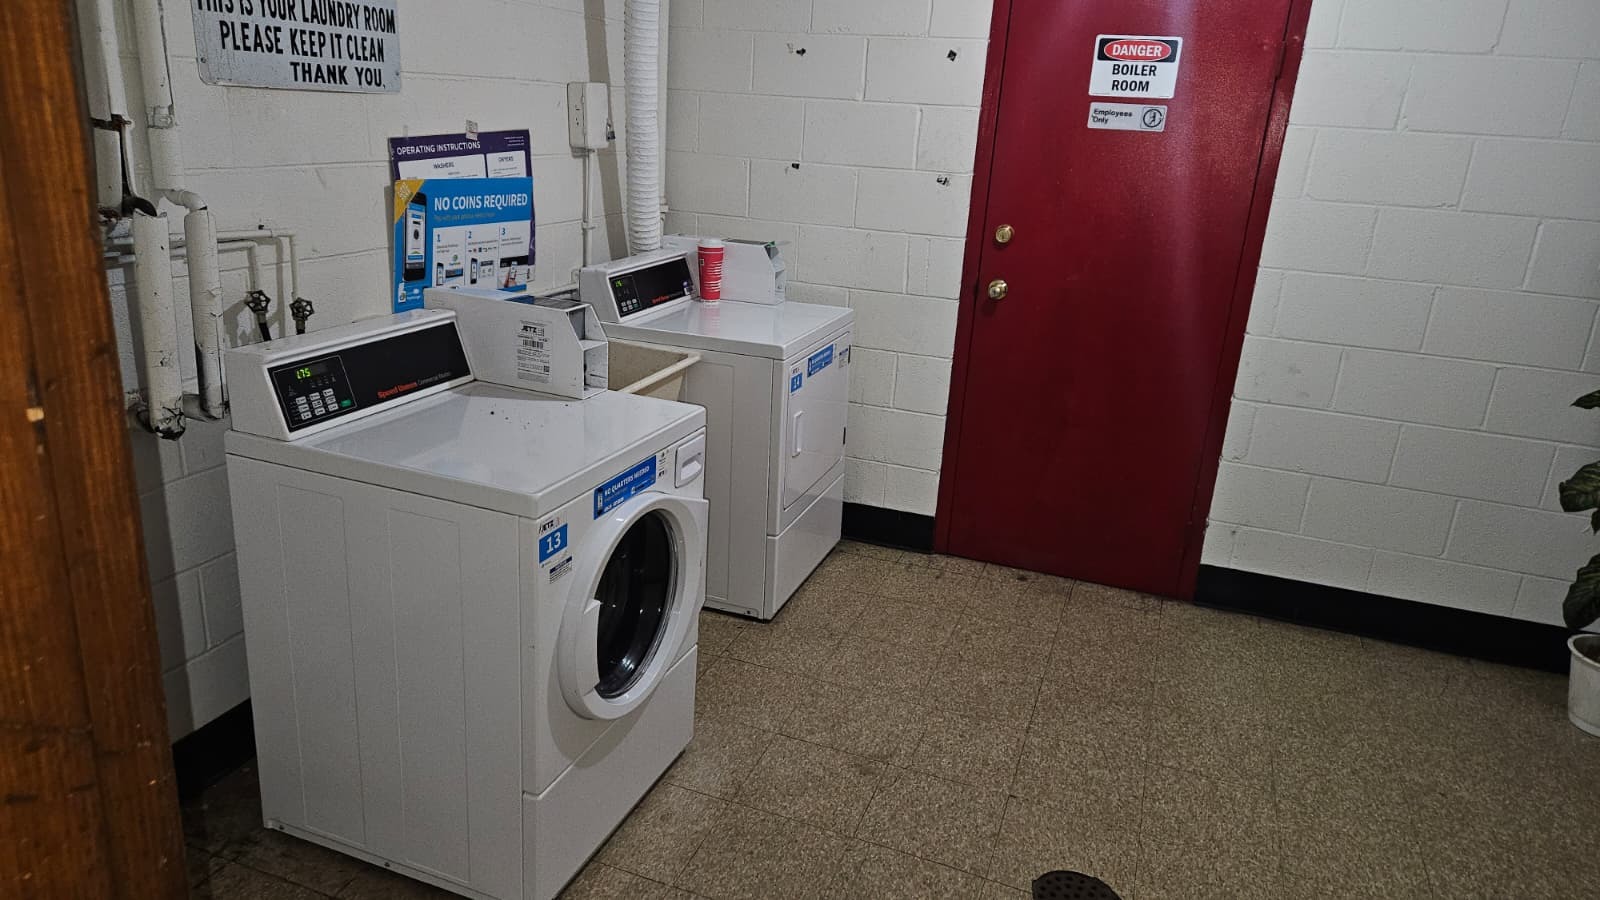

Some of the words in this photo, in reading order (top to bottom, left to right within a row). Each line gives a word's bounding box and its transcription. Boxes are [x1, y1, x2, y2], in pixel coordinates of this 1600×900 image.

[260, 0, 297, 21] YOUR
[302, 0, 360, 29] LAUNDRY
[364, 6, 396, 34] ROOM
[219, 20, 284, 54] PLEASE
[289, 28, 326, 58] KEEP
[330, 33, 343, 59] IT
[347, 35, 385, 62] CLEAN
[1112, 44, 1162, 57] DANGER
[290, 62, 348, 85] THANK
[1112, 64, 1157, 76] BOILER
[1112, 80, 1150, 92] ROOM
[1093, 108, 1133, 117] Employees
[1092, 116, 1109, 124] Only
[397, 144, 435, 155] OPERATING
[437, 141, 481, 152] INSTRUCTIONS
[433, 161, 454, 169] WASHERS
[434, 198, 450, 211] NO
[452, 195, 482, 210] COINS
[484, 193, 528, 210] REQUIRED
[468, 231, 472, 239] 2
[501, 227, 506, 236] 3
[611, 476, 634, 494] QUARTERS
[546, 531, 562, 554] 13
